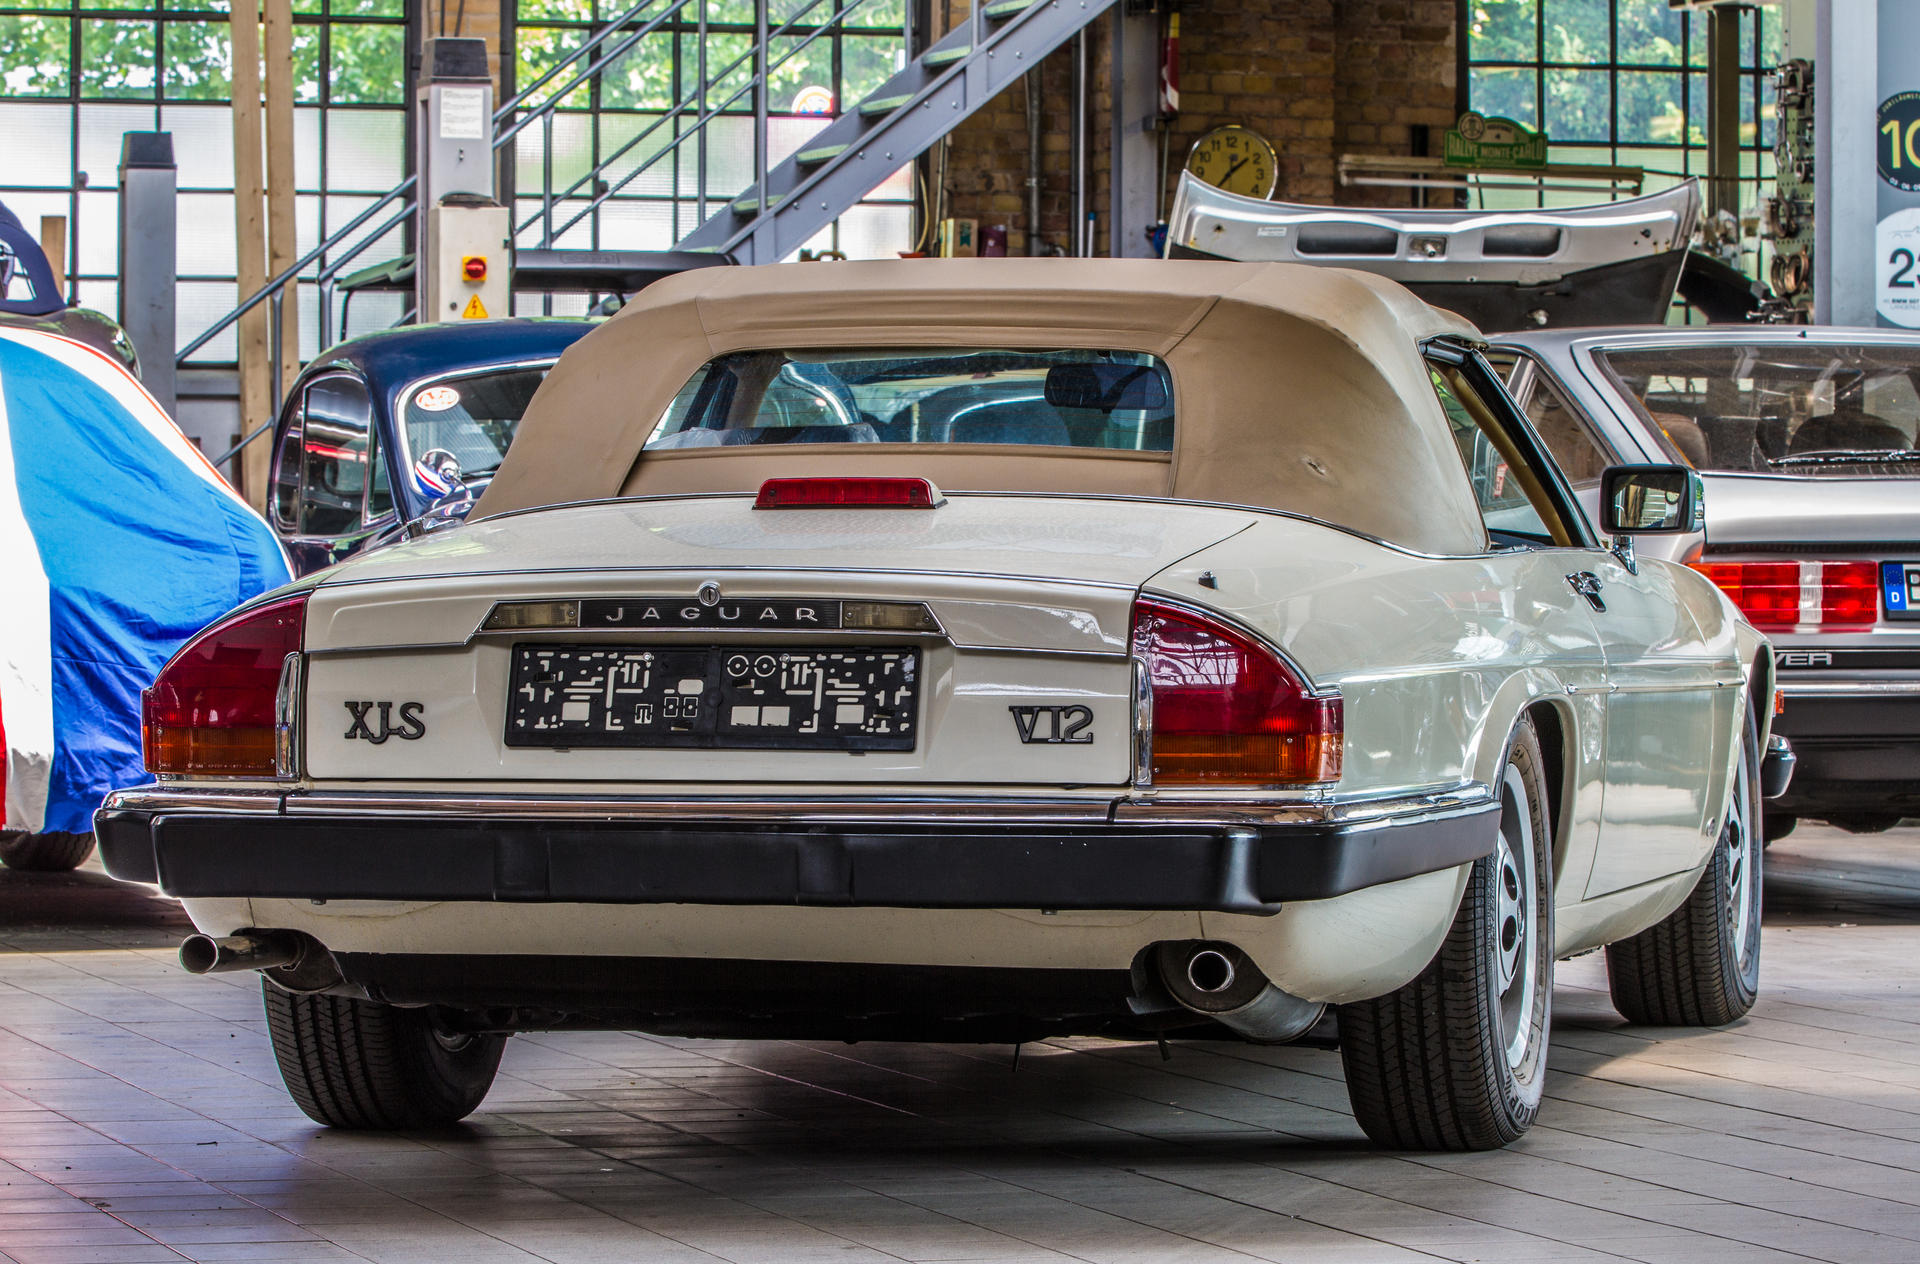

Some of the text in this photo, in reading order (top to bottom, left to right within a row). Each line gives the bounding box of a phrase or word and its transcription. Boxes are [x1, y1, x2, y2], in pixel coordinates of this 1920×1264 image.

[1211, 139, 1221, 152] 11
[1225, 136, 1238, 148] 12
[1244, 141, 1249, 152] 1
[1448, 131, 1478, 157] RALLYE
[1198, 151, 1211, 163] 10
[1252, 152, 1261, 165] 2
[1196, 166, 1205, 178] 9
[1256, 168, 1265, 181] 3
[1250, 184, 1259, 194] 4
[1891, 591, 1900, 603] D
[606, 606, 818, 622] JAGUAR
[344, 702, 425, 745] XJS
[1008, 704, 1093, 744] V12
